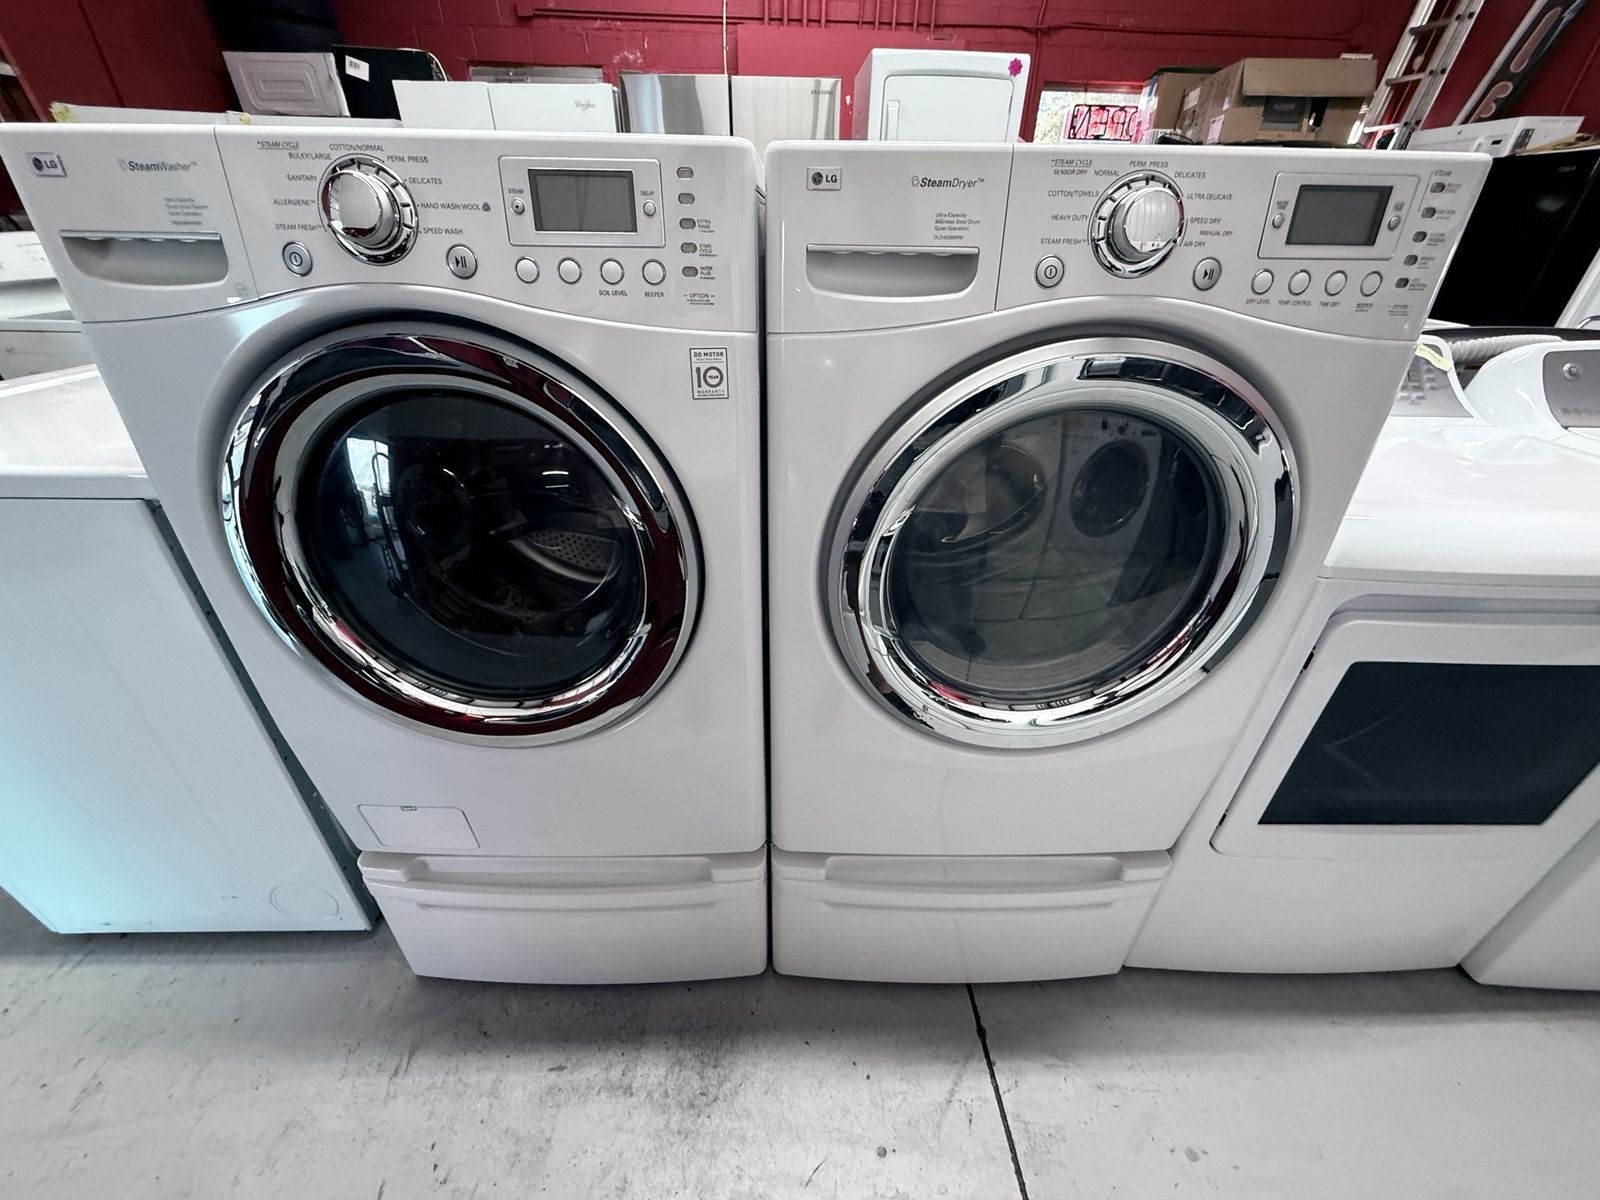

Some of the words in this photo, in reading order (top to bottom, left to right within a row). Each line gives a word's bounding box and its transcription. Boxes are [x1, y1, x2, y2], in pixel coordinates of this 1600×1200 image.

[329, 143, 384, 152] COTTON/NORMAL
[288, 151, 332, 160] BULKY/LARGE
[386, 154, 406, 163] PERM.
[408, 155, 429, 164] PRESS
[44, 159, 58, 170] LG
[1149, 160, 1169, 169] PRESS
[1053, 168, 1076, 176] SENSOR
[1076, 168, 1088, 176] DRY
[1094, 169, 1120, 177] NORMAL
[1174, 171, 1207, 180] DELICATES
[286, 174, 318, 182] SANITARY
[408, 177, 443, 185] DELICATES
[825, 174, 838, 184] LG
[1048, 190, 1100, 198] COTTON/TOWELS
[441, 202, 481, 211] WASH/WOOL
[1072, 214, 1089, 222] DUTY
[1190, 216, 1210, 224] SPEED
[1209, 216, 1222, 225] DRY
[275, 223, 297, 231] STEAM
[423, 226, 444, 235] SPEED
[444, 226, 464, 235] WASH
[1040, 237, 1062, 246] STEAM
[1193, 240, 1207, 249] DRY
[598, 289, 611, 297] SOIL
[611, 289, 628, 297] LEVEL
[695, 365, 724, 389] 10
